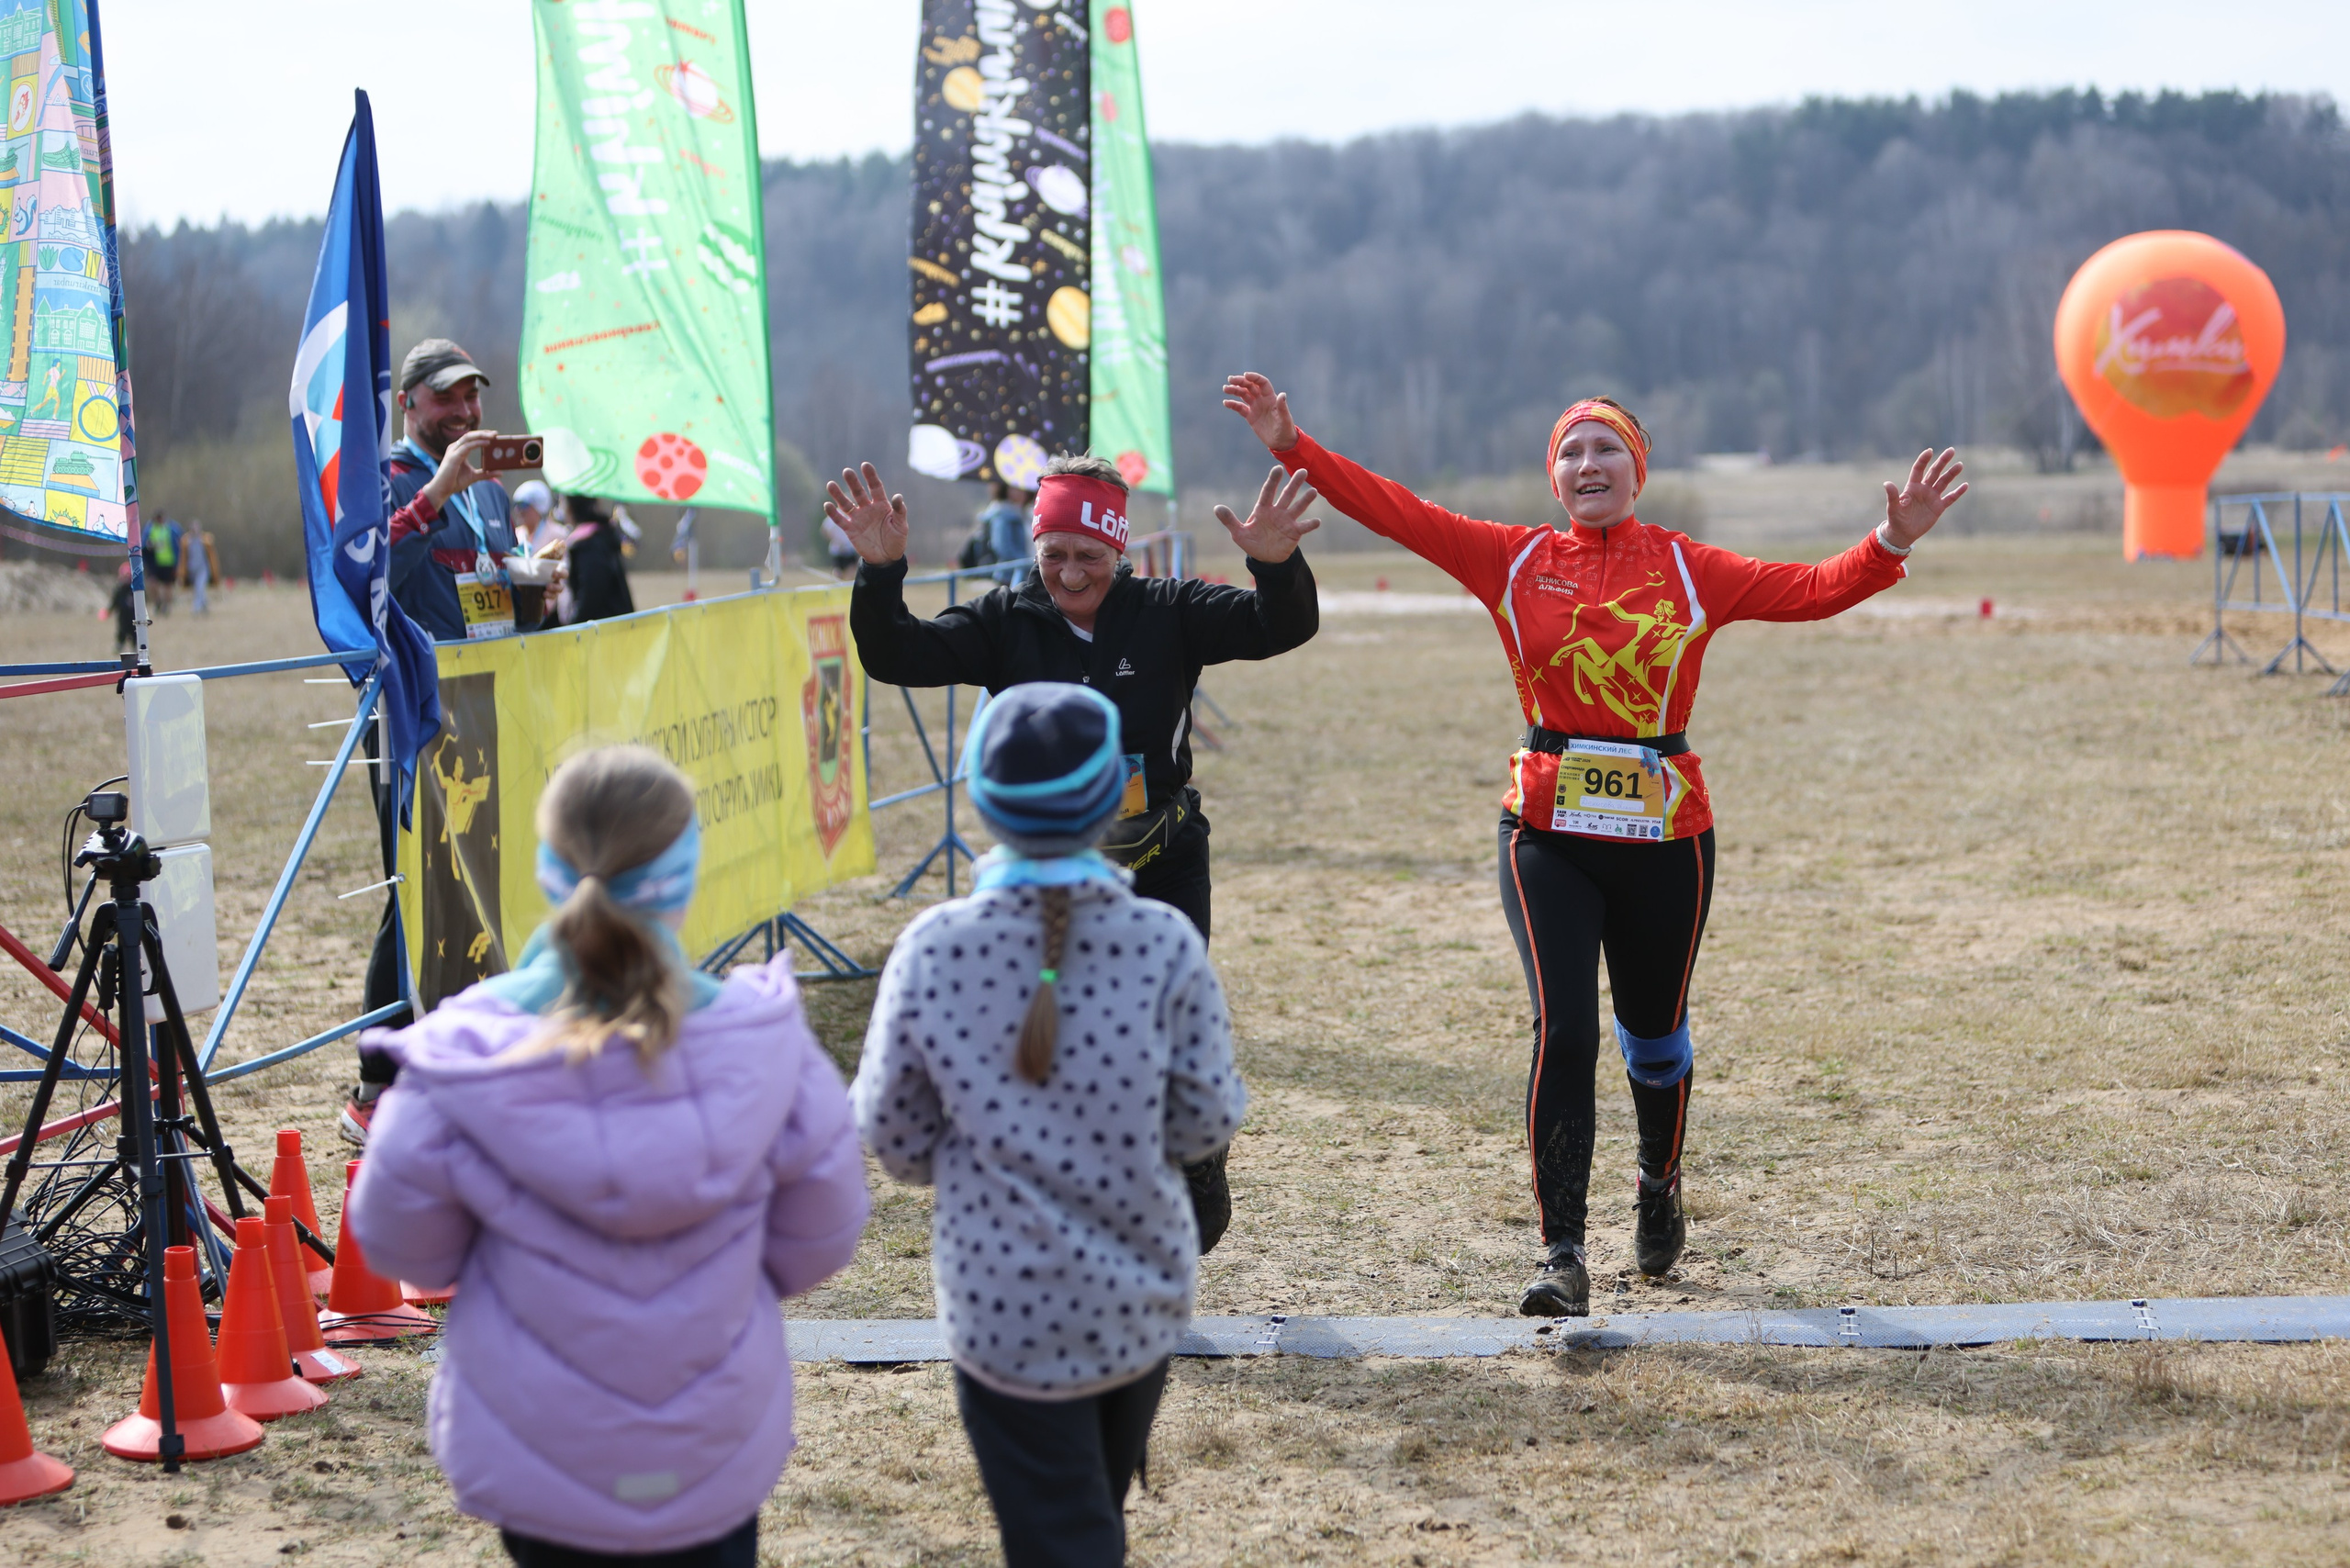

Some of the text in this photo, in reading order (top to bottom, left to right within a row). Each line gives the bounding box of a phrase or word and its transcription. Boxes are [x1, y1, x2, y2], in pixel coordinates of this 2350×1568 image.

[1534, 575, 1579, 588] ДЕНИСОВА
[1538, 583, 1573, 596] АЛЬФИЯ
[474, 589, 500, 611] 917
[1570, 742, 1617, 753] ХИМКИНСКИЙ
[1584, 767, 1642, 800] 961
